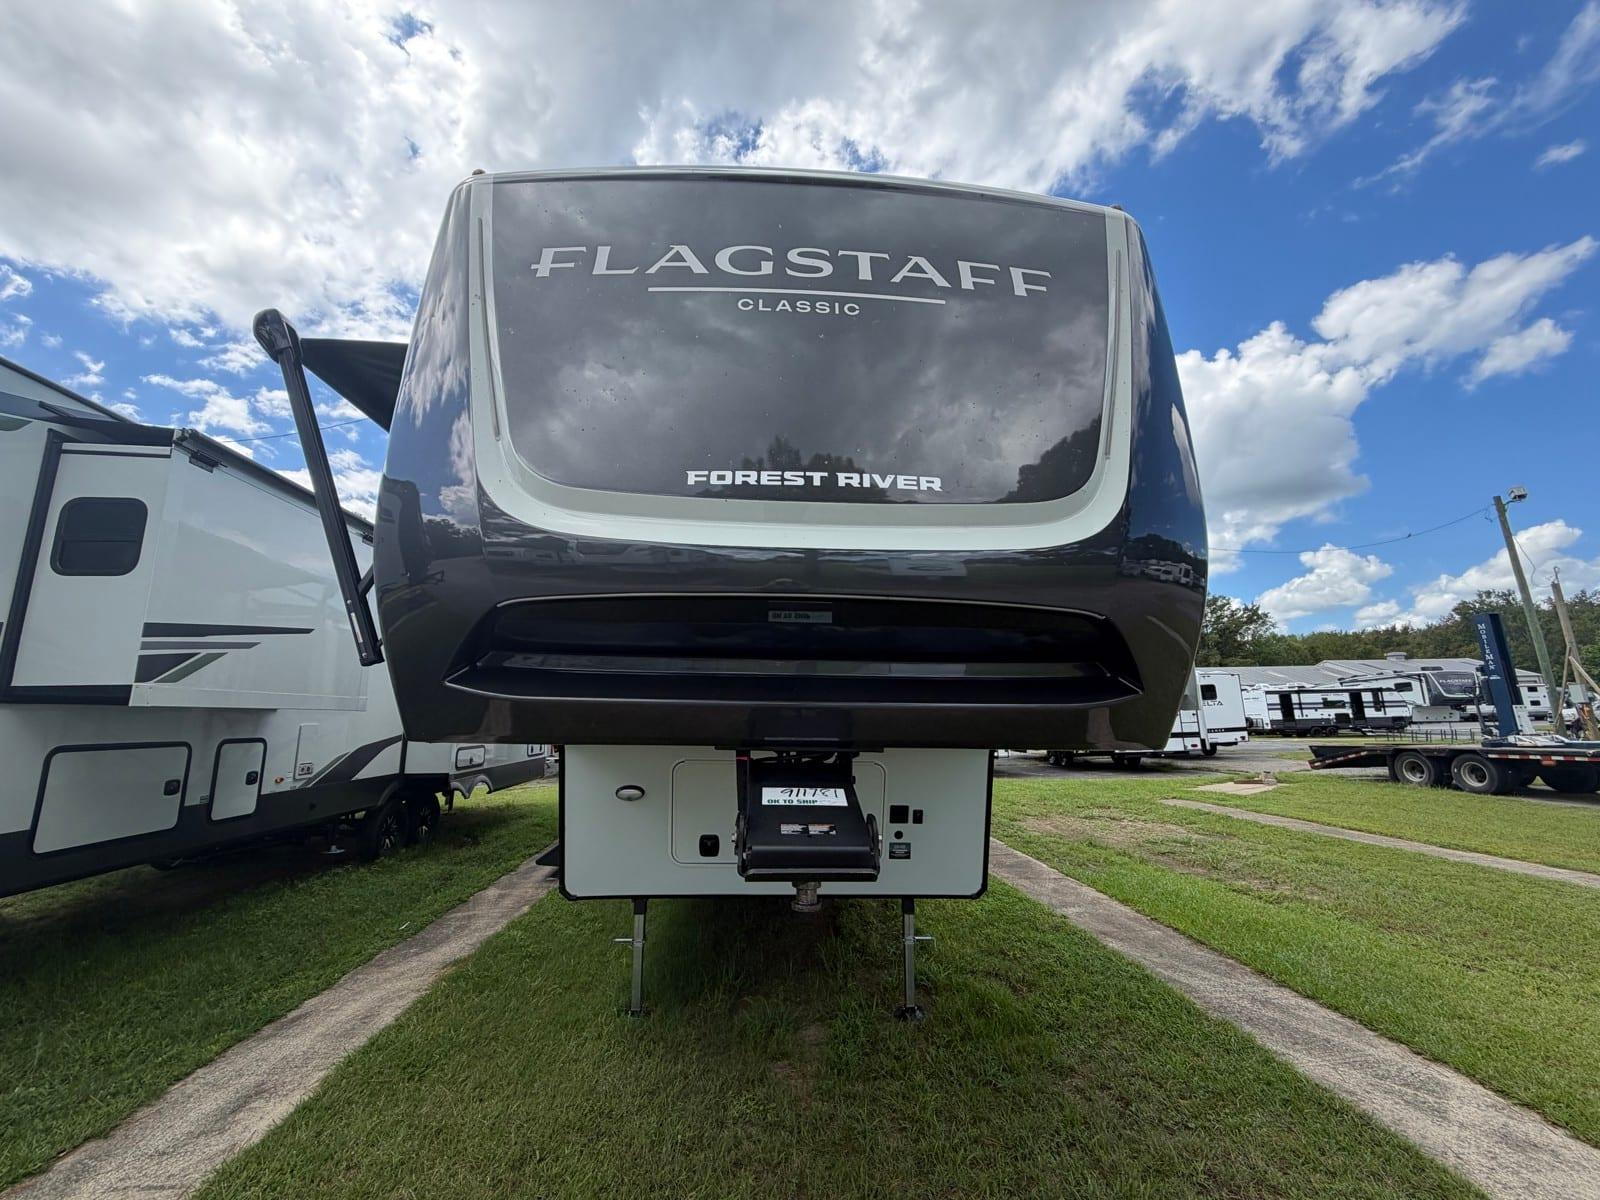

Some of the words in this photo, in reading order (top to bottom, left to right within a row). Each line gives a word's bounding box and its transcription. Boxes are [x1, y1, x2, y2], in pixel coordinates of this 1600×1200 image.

[530, 244, 1052, 297] FLAGSTAFF
[737, 298, 861, 316] CLASSIC
[686, 470, 828, 487] FOREST
[836, 472, 943, 492] RIVER
